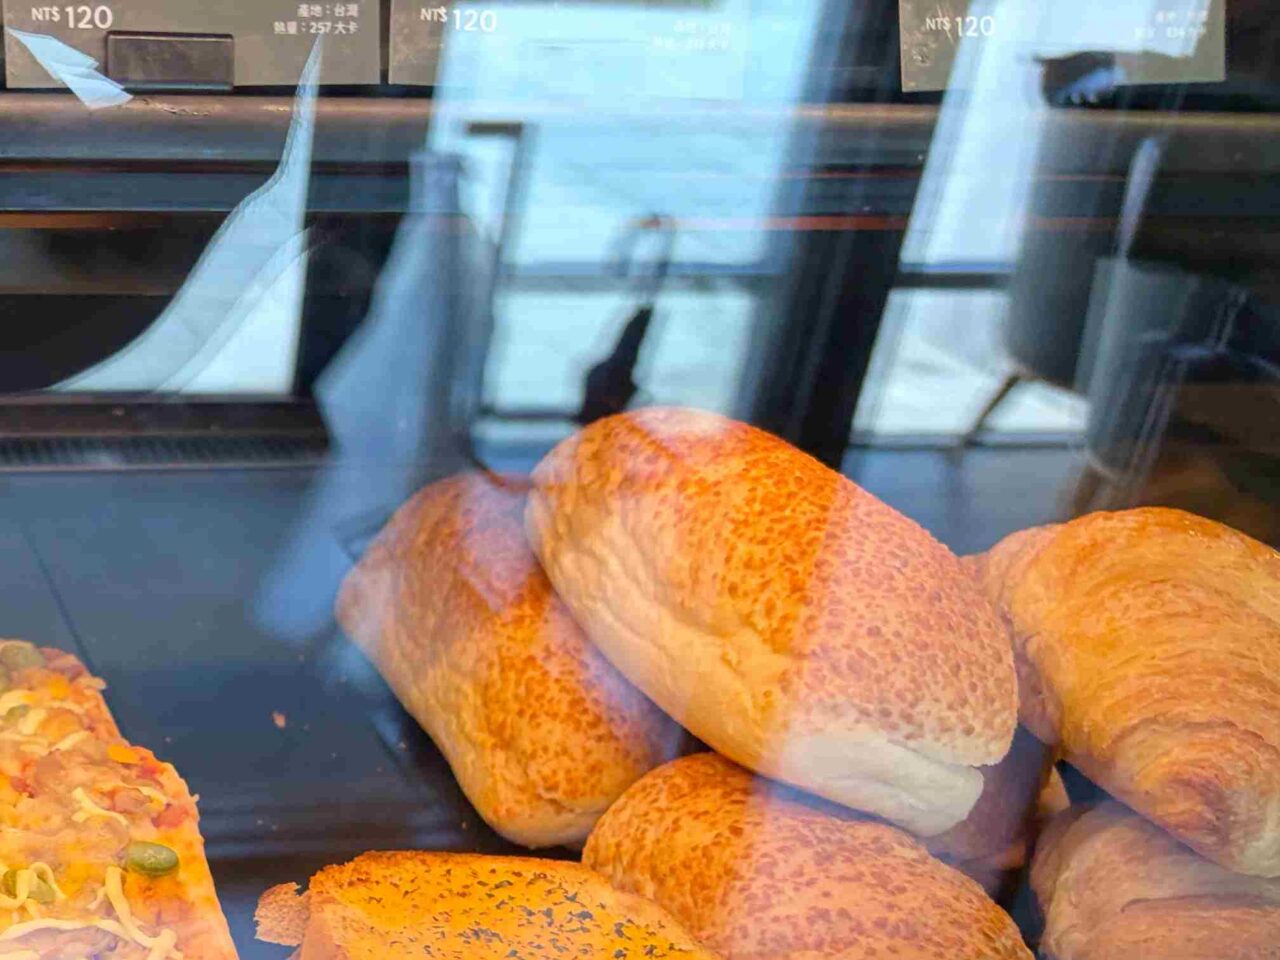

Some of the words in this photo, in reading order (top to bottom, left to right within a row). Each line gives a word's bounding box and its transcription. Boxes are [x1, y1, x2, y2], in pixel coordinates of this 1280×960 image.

[31, 6, 60, 22] NT$
[65, 5, 113, 29] 120
[420, 6, 448, 22] NT$
[453, 9, 497, 32] 120
[955, 15, 995, 37] 120
